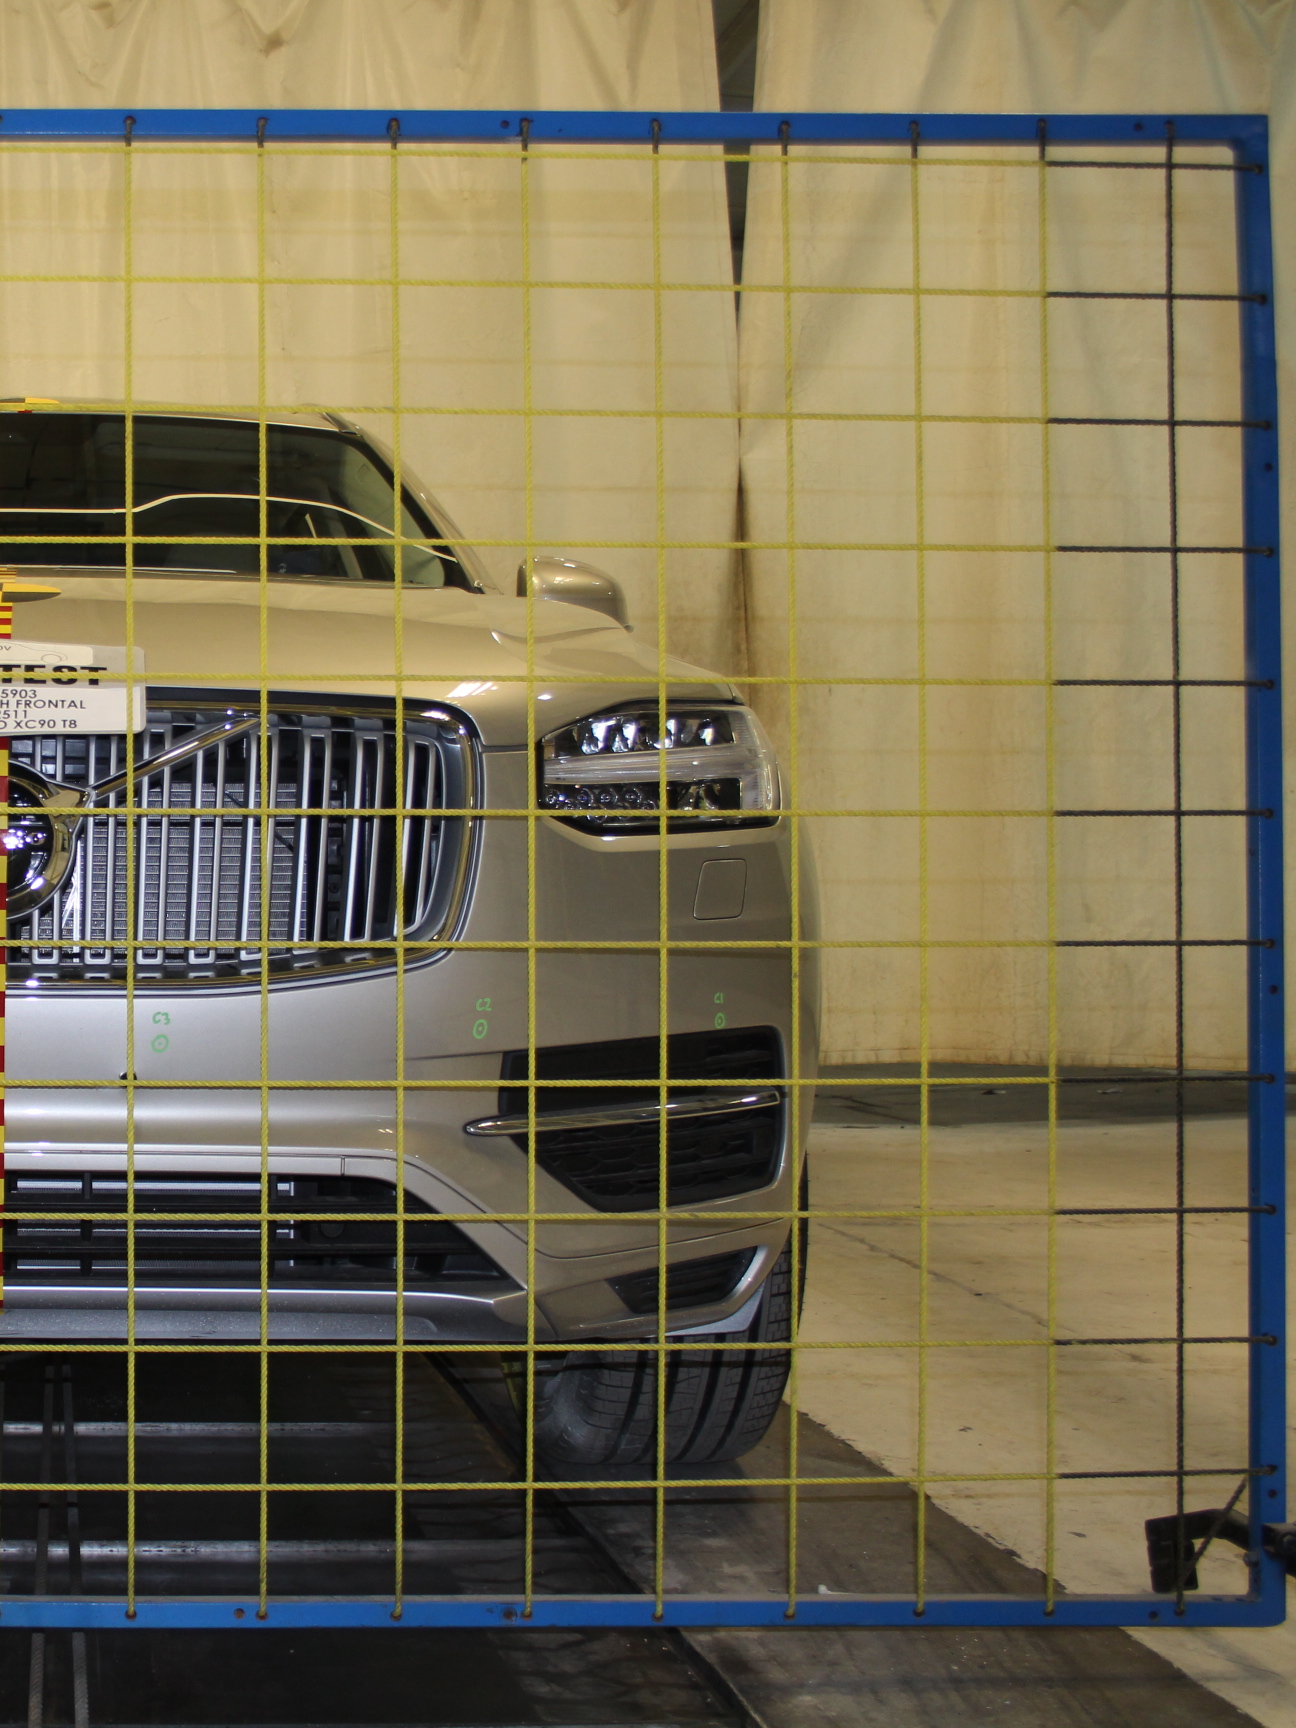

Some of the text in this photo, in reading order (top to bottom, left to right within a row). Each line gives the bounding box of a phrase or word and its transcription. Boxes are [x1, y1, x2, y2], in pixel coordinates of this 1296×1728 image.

[15, 699, 86, 709] FRONTAL
[13, 719, 57, 730] XC90
[61, 719, 78, 729] T8
[475, 998, 493, 1012] C2
[152, 1011, 172, 1025] C3
